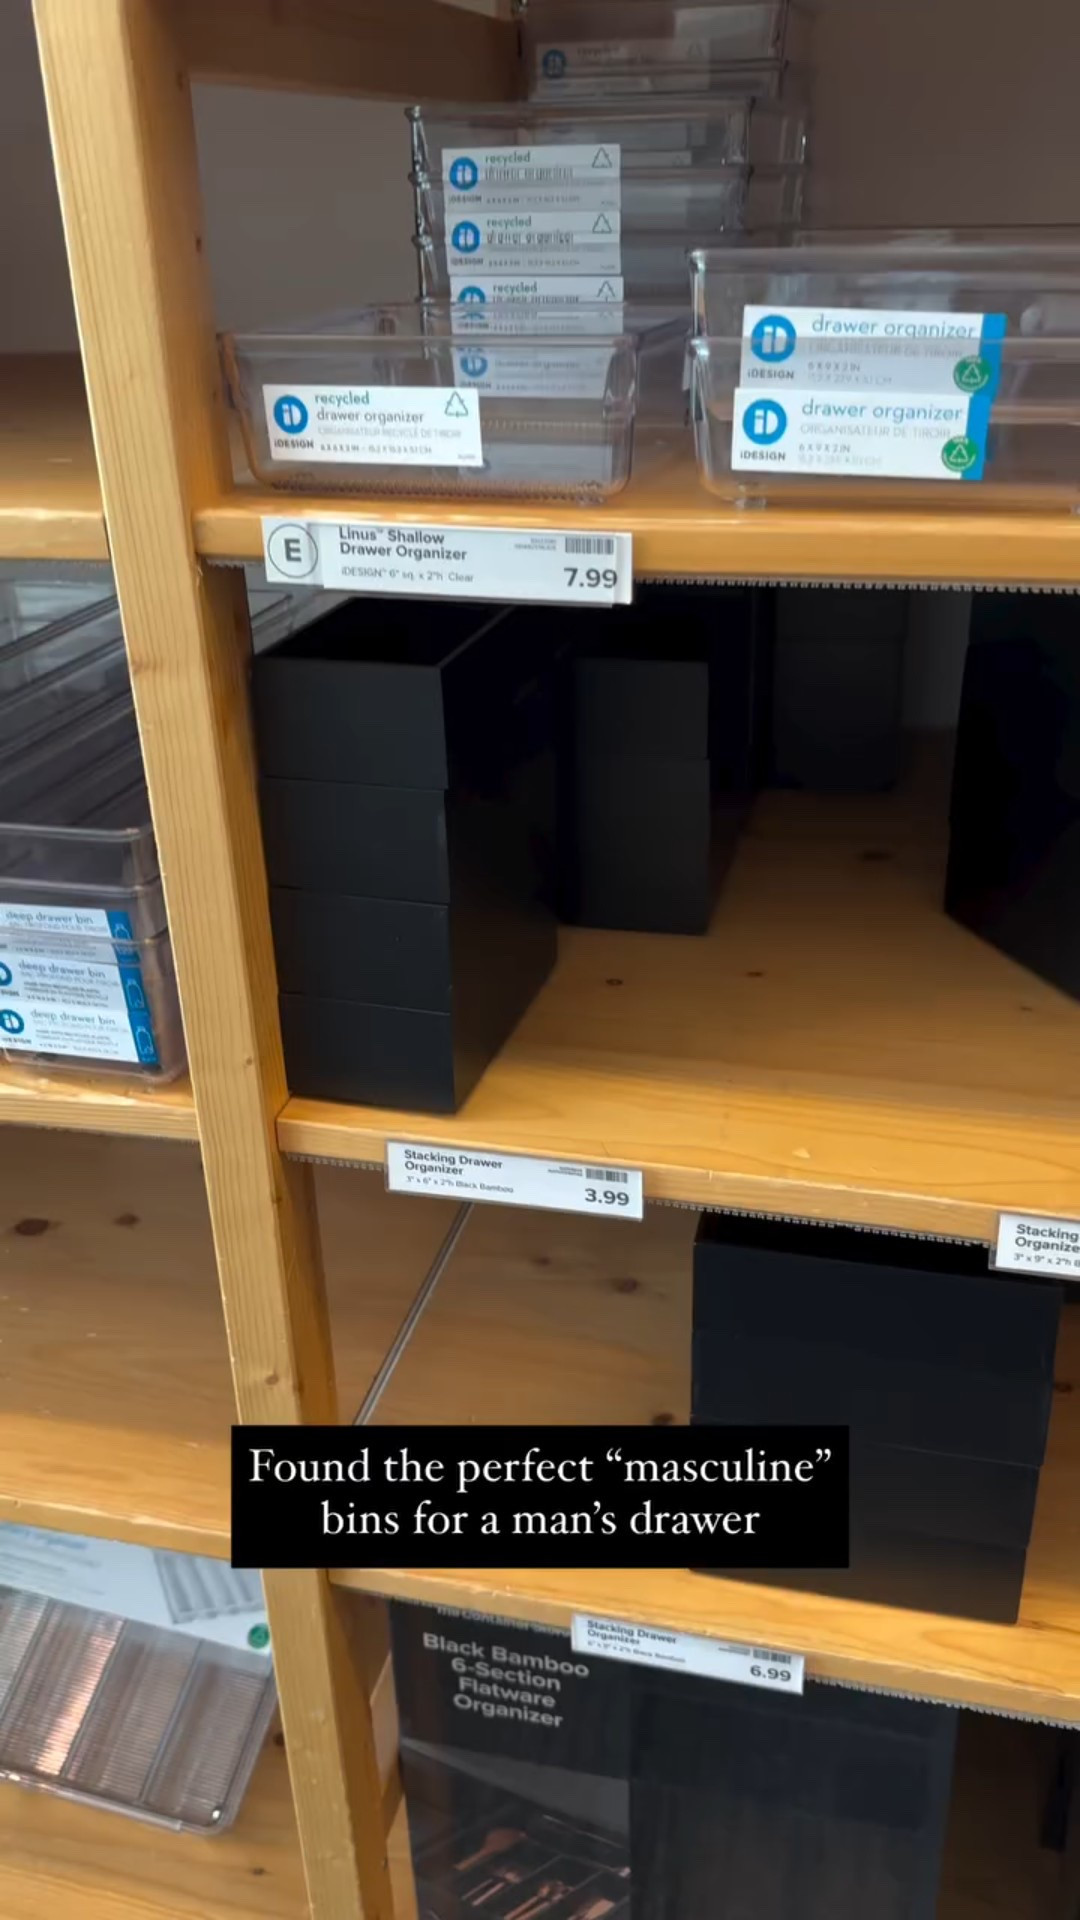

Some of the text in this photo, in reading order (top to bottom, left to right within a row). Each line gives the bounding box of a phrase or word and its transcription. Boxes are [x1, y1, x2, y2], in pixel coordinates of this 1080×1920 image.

[485, 152, 530, 165] recycled
[487, 216, 532, 228] recycled
[493, 281, 538, 294] recycled
[812, 314, 976, 340] drawer organizer
[748, 368, 794, 379] iDESIGN
[314, 391, 370, 407] recycled
[316, 407, 424, 425] drawer organizer
[802, 398, 962, 424] drawer organizer
[894, 427, 907, 438] DE
[274, 440, 314, 450] iDESIGN
[740, 450, 786, 460] iDESIGN
[388, 528, 445, 544] Shallow
[284, 539, 302, 562] E
[340, 543, 467, 561] Drawer Organizer
[448, 572, 474, 582] Clear
[564, 567, 618, 589] 7.99
[36, 911, 72, 924] drawer
[75, 912, 94, 924] bin
[49, 963, 85, 977] drawer
[88, 966, 106, 979] bin
[60, 1010, 96, 1024] drawer
[99, 1014, 116, 1026] bin
[404, 1149, 503, 1169] Stacking Drawer
[404, 1161, 464, 1175] Organizer
[456, 1180, 478, 1189] Black
[480, 1183, 514, 1193] Bamboo
[585, 1188, 630, 1206] 3.99
[1016, 1223, 1080, 1243] Stacking
[588, 1619, 634, 1637] Stacking
[637, 1628, 677, 1644] Drawer
[588, 1629, 640, 1645] Organizer
[423, 1632, 590, 1677] Black Bamboo
[451, 1657, 561, 1692] 6-Section
[750, 1665, 791, 1682] 6.99
[459, 1676, 556, 1708] Flatware
[453, 1693, 563, 1727] Organizer
